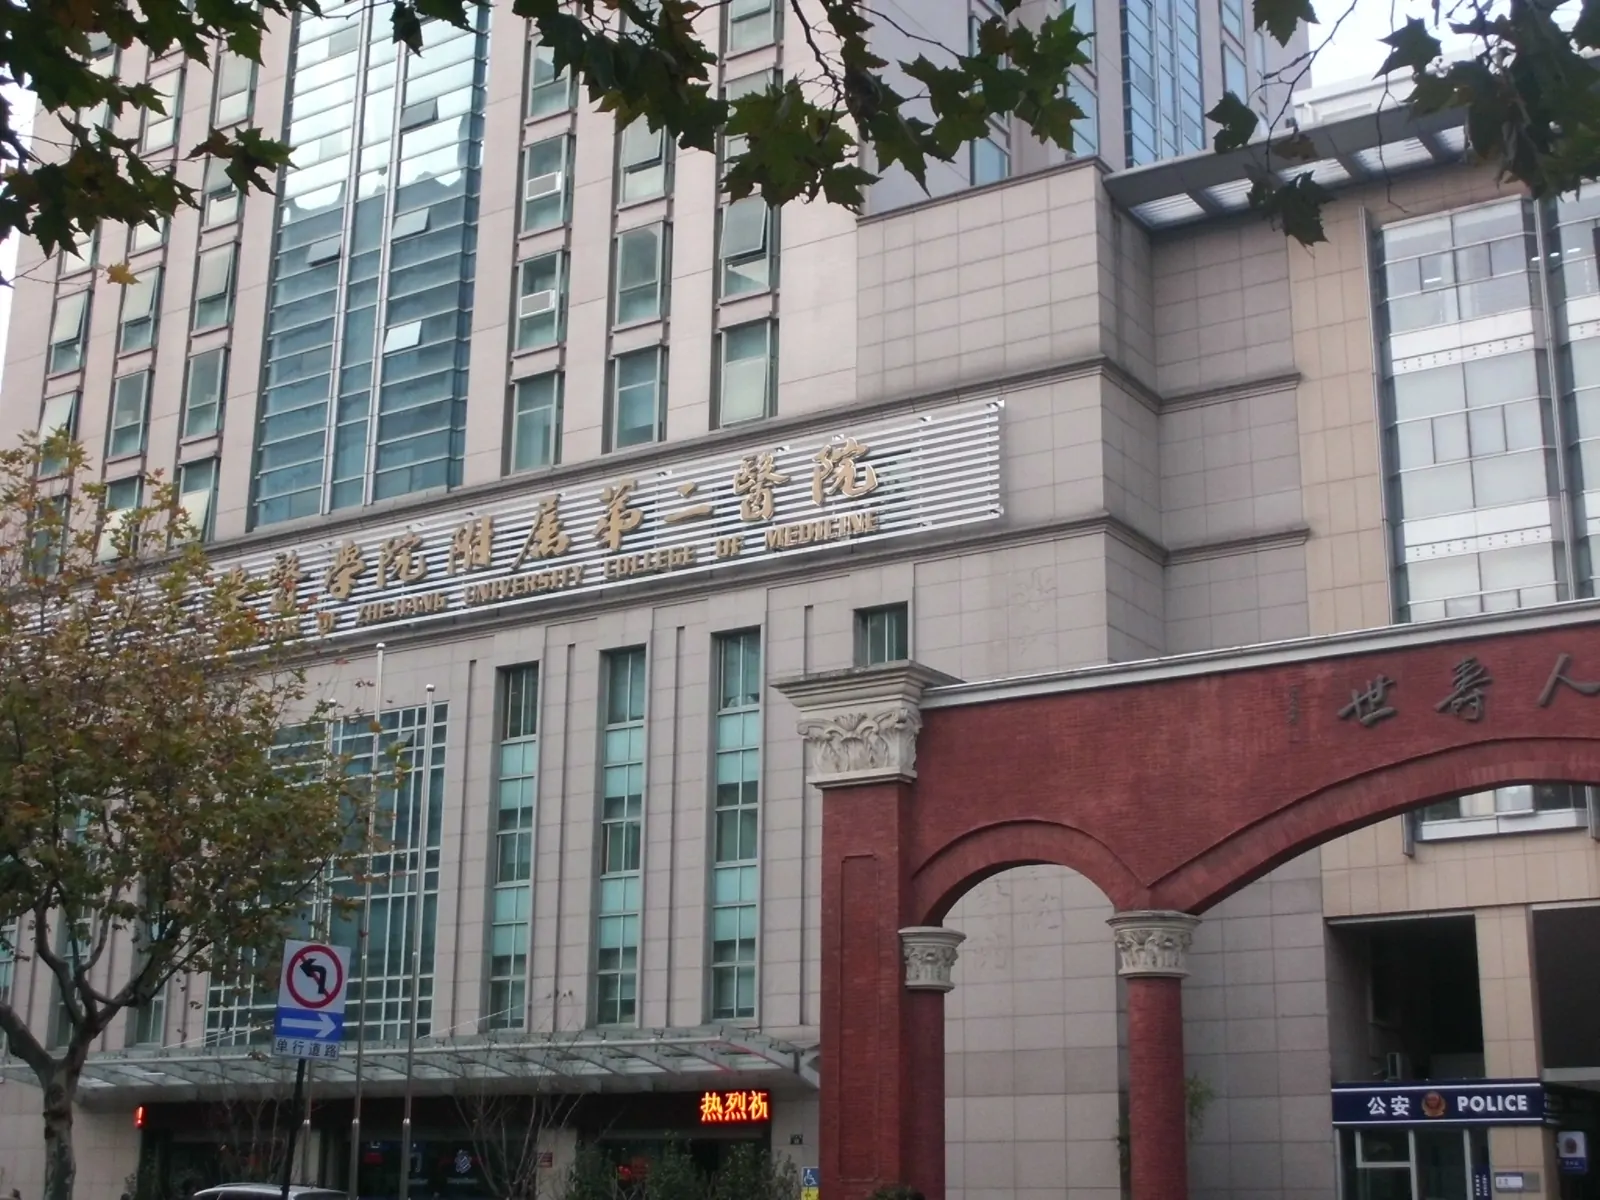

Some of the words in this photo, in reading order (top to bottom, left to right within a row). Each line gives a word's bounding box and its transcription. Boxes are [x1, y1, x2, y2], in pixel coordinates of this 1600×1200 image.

[356, 590, 447, 627] ZHEJIANG
[464, 563, 585, 606] UNIVERSITY
[603, 545, 697, 579] COLLEGE
[716, 533, 745, 558] OF
[765, 509, 880, 550] MEDICINE
[276, 1039, 337, 1058] 单行道路
[1367, 1095, 1411, 1116] 公安
[1457, 1094, 1528, 1112] POLICE
